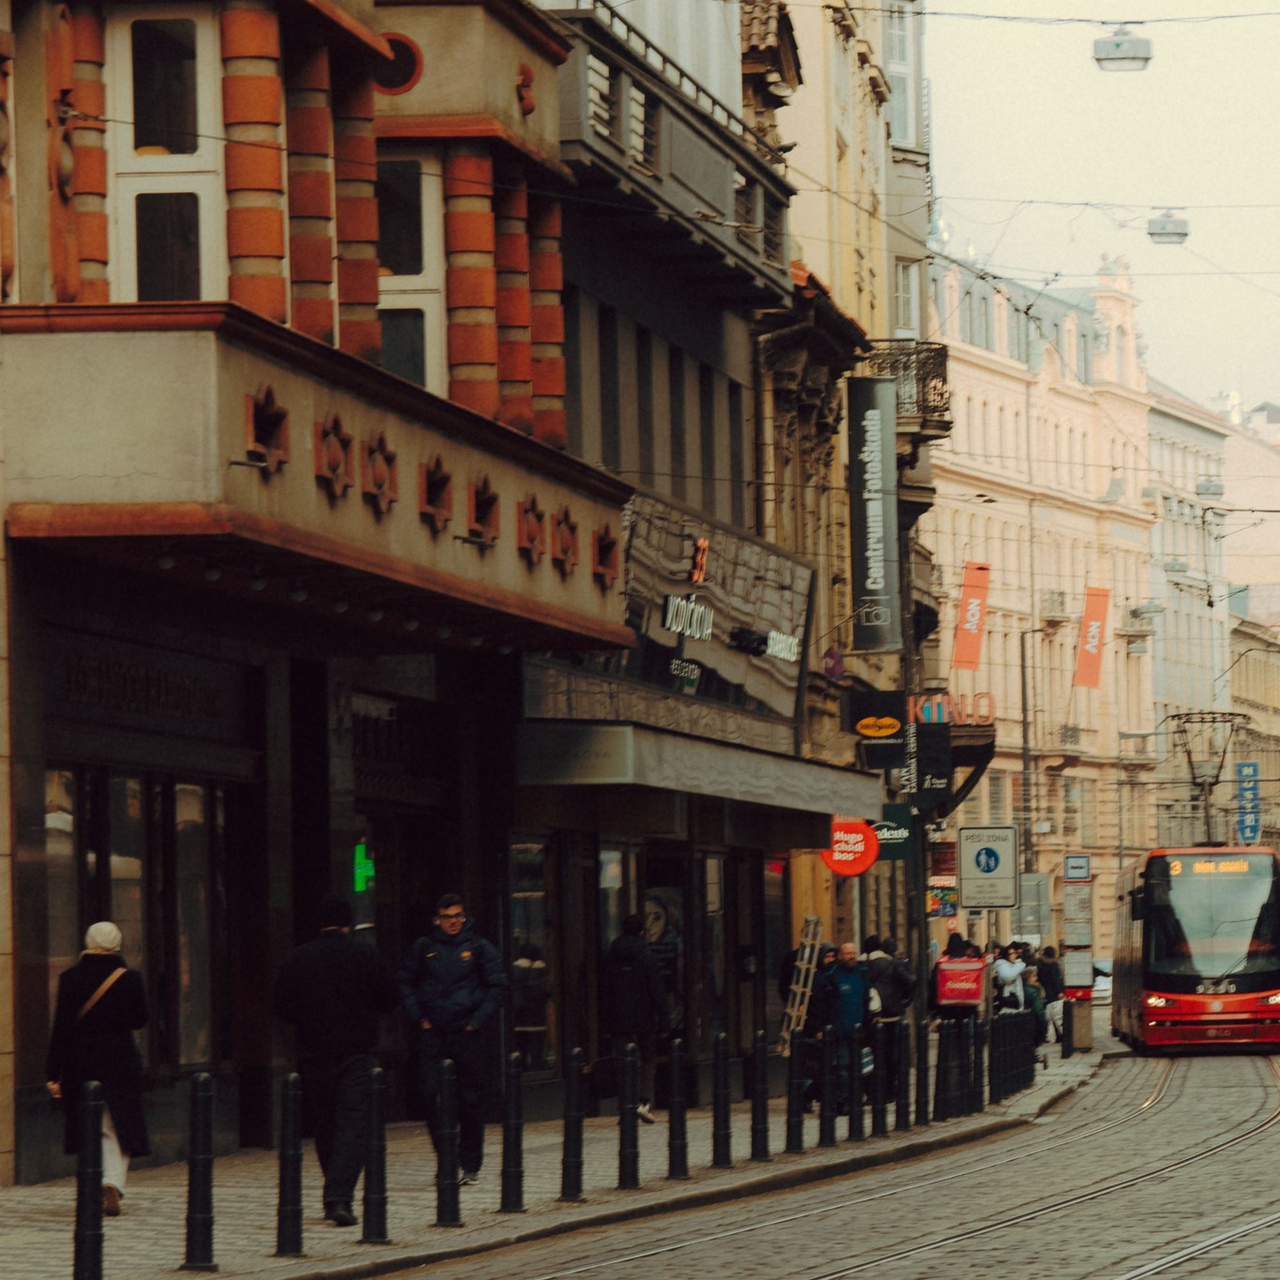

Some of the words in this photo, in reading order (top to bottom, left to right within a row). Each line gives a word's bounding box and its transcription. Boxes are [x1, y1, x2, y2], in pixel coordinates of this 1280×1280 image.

[858, 409, 883, 499] FotoŠkoda
[865, 500, 885, 590] Centrum
[962, 598, 982, 634] AON
[1083, 620, 1101, 655] AON
[907, 692, 996, 726] KINO
[1170, 860, 1182, 876] 3
